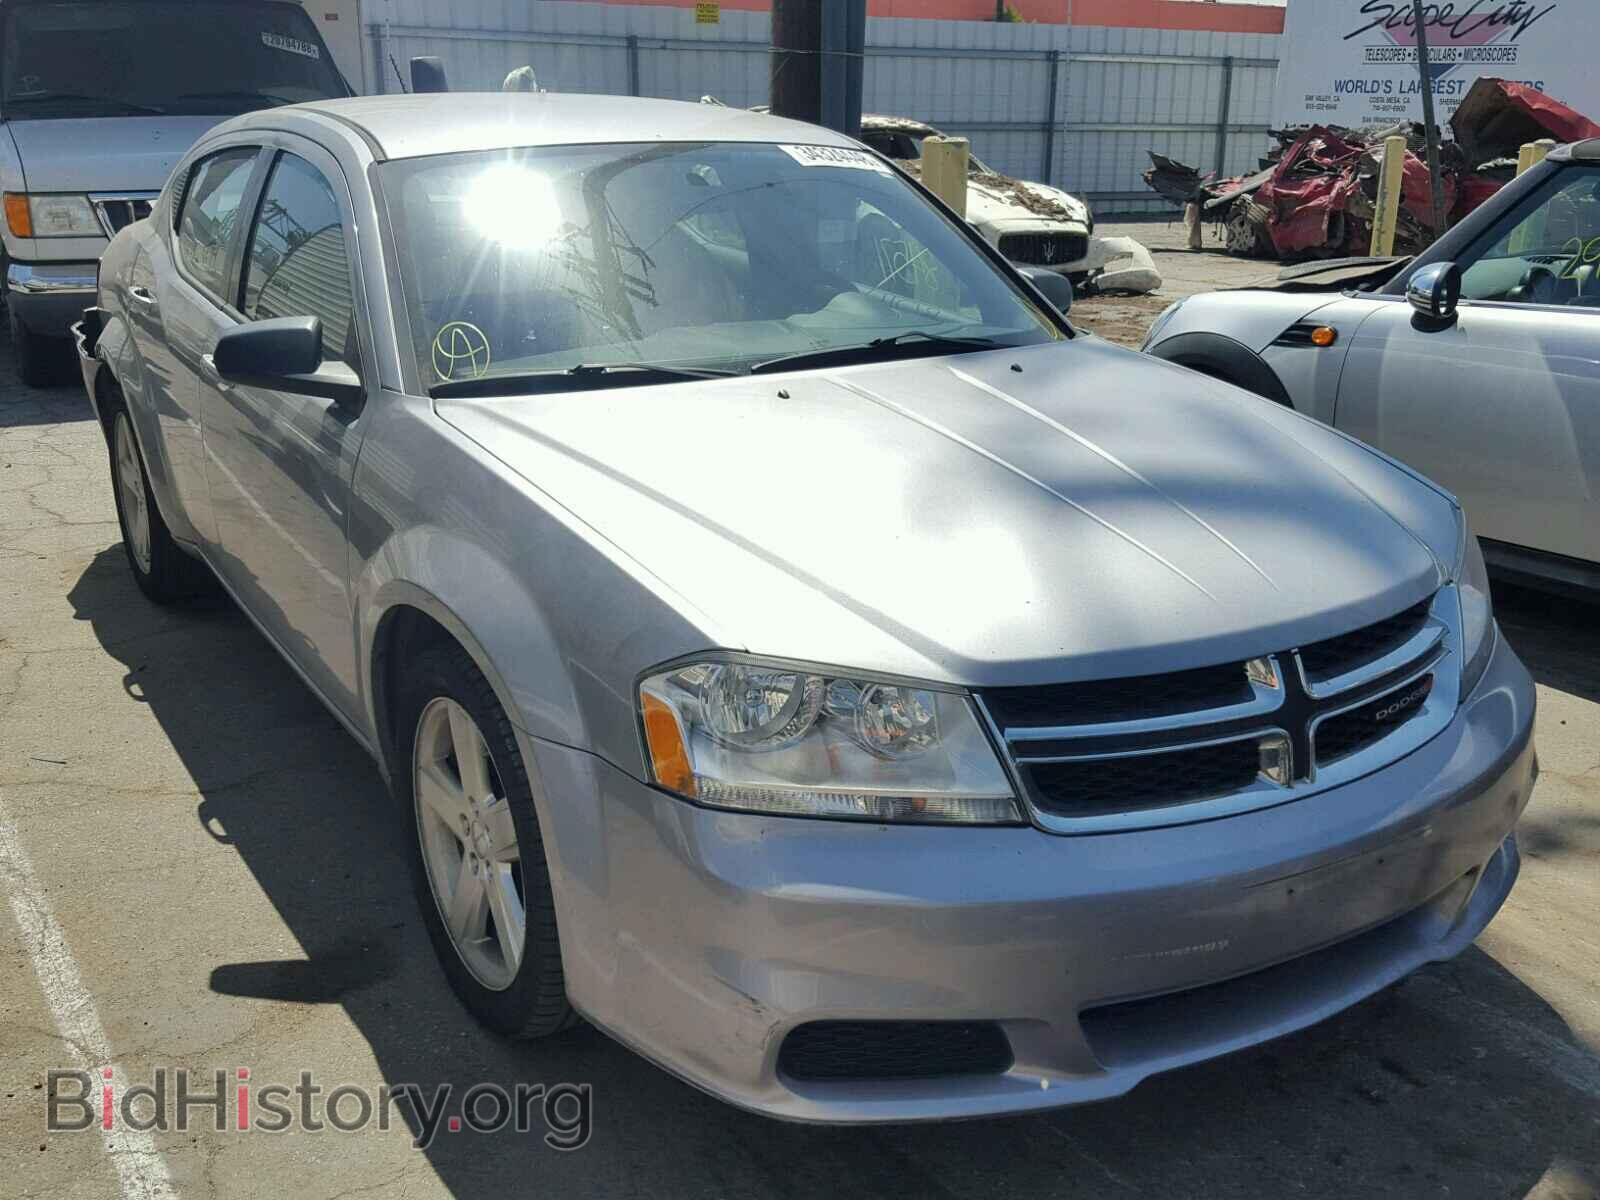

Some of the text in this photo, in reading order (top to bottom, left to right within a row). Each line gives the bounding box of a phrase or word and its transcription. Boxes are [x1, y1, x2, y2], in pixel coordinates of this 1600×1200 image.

[1450, 0, 1556, 42] City
[1364, 48, 1518, 62] TELESCOPES BCULARS MICROSCOPES
[1334, 79, 1393, 94] WORLD'S
[1376, 688, 1425, 721] DODGE
